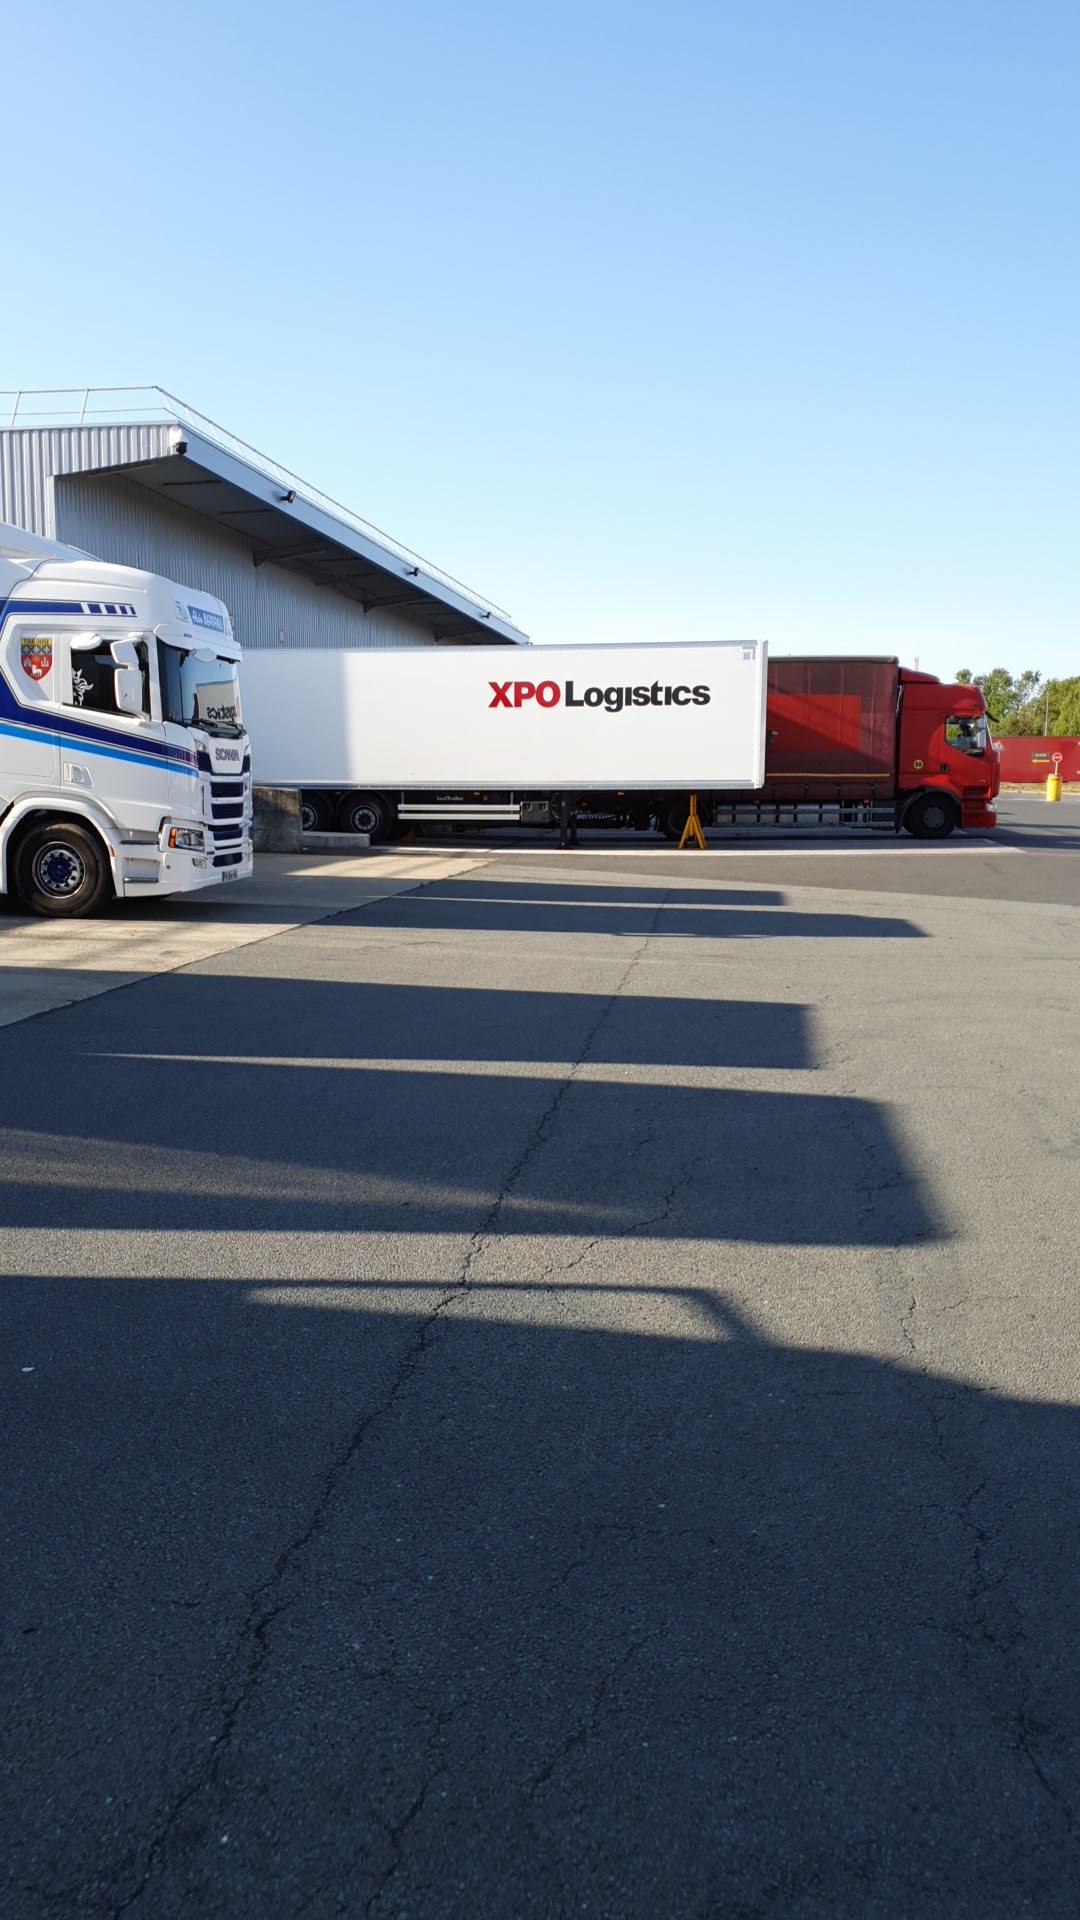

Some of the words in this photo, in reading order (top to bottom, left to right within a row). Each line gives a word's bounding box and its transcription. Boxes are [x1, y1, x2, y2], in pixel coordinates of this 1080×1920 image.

[23, 637, 50, 645] TOULOUSE
[488, 680, 561, 708] XPO
[565, 680, 711, 713] Logistics
[215, 747, 240, 761] SCANIA
